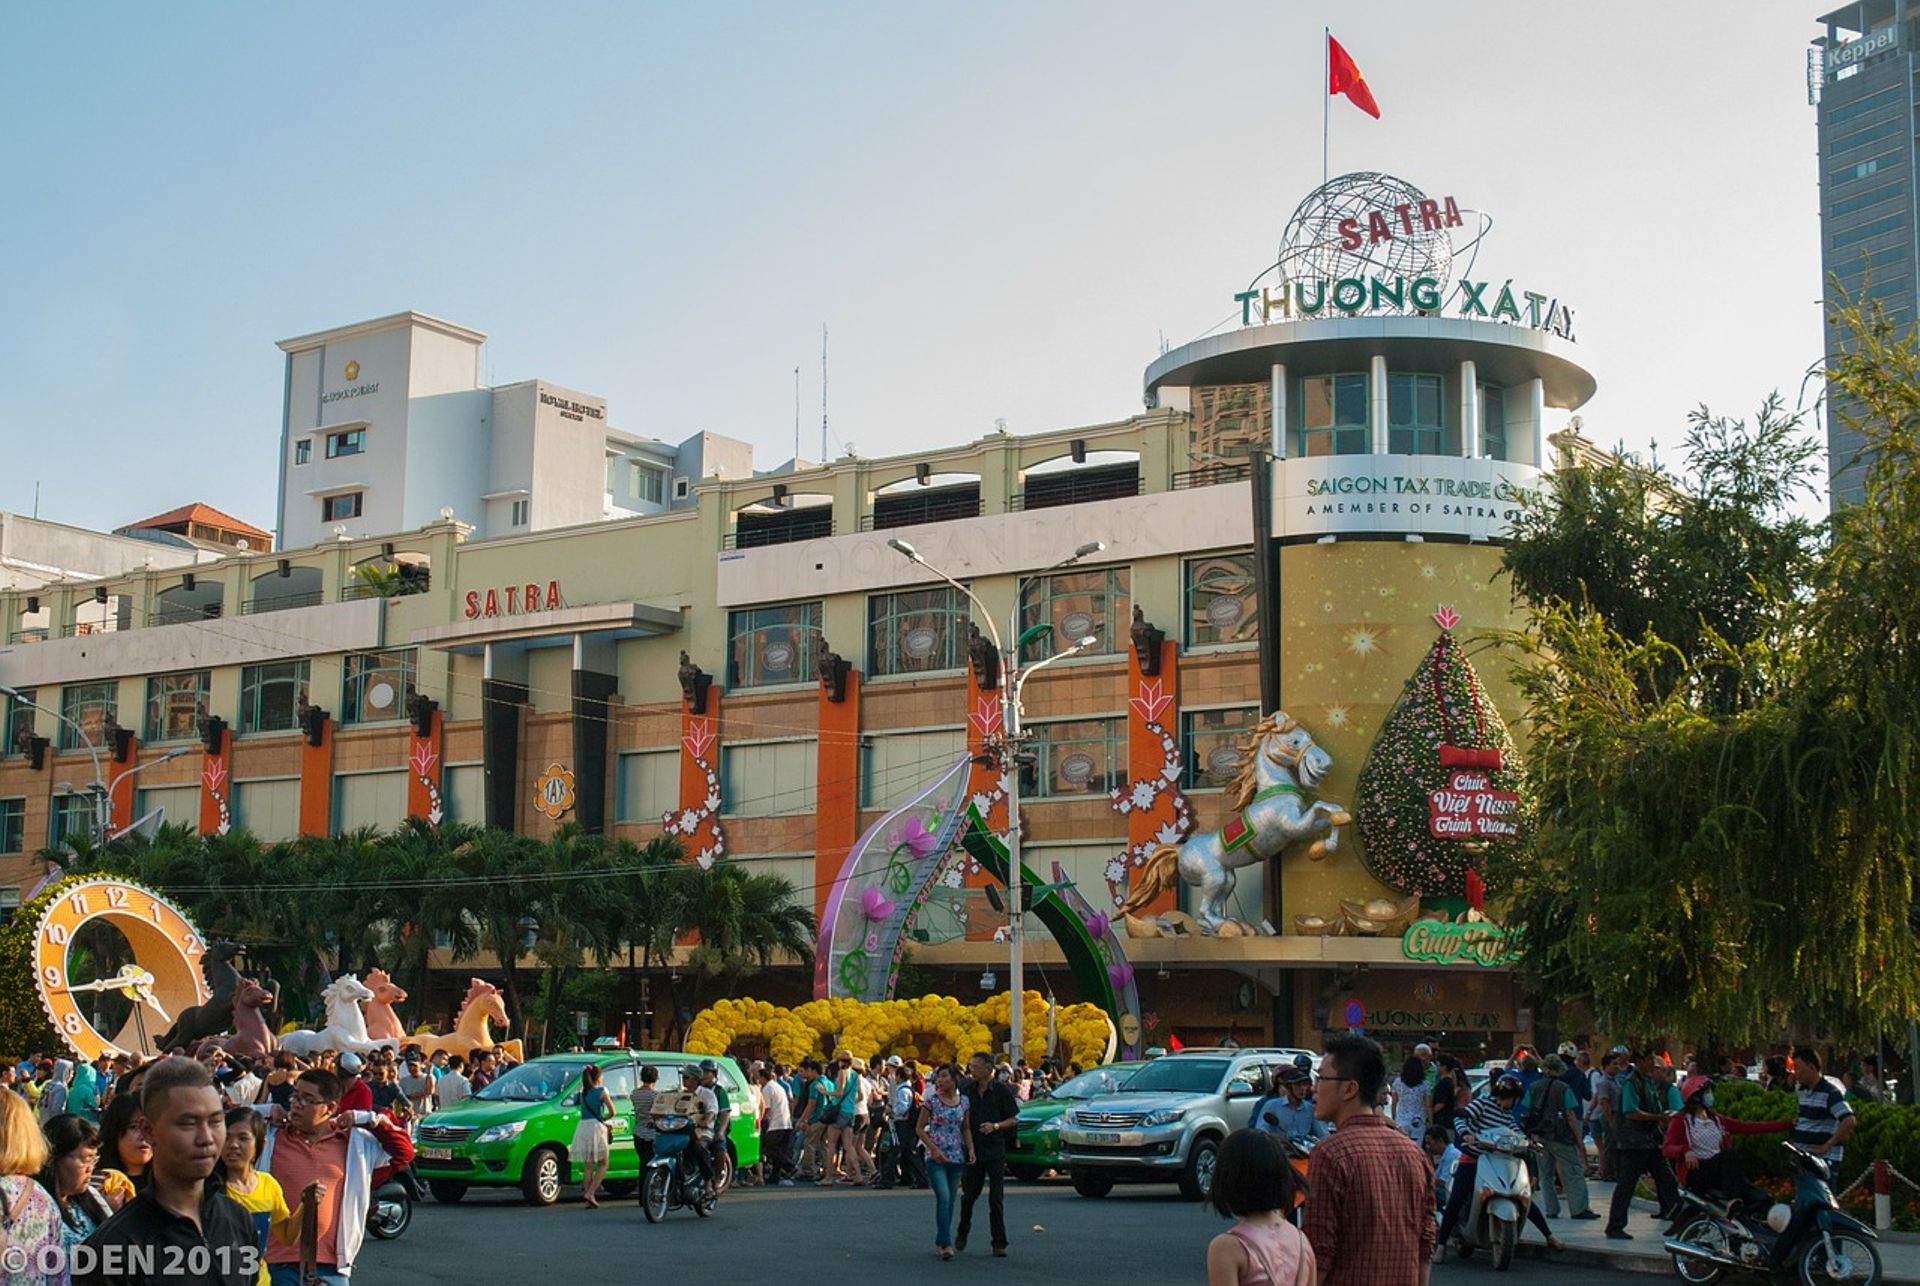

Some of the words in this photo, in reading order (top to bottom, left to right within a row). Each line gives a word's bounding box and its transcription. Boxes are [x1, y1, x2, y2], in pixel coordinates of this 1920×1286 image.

[1828, 27, 1894, 67] Keppel
[1338, 195, 1464, 252] SATRA
[1307, 475, 1388, 496] SAIGON
[1393, 476, 1430, 495] TAX
[1434, 477, 1492, 499] TRADE
[1306, 505, 1316, 516] A
[1322, 503, 1400, 515] MEMBER
[1410, 503, 1433, 514] OF
[1442, 504, 1498, 519] SATRA
[464, 580, 561, 620] SATRA
[1453, 774, 1488, 792] Chúc
[1433, 791, 1472, 817] Việt
[1435, 816, 1473, 836] Thịnh
[70, 893, 89, 915] 11
[105, 887, 130, 908] 12
[149, 902, 163, 922] 1
[45, 923, 68, 945] 10
[183, 933, 200, 955] 2
[44, 966, 63, 988] 9
[63, 1013, 83, 1034] 8
